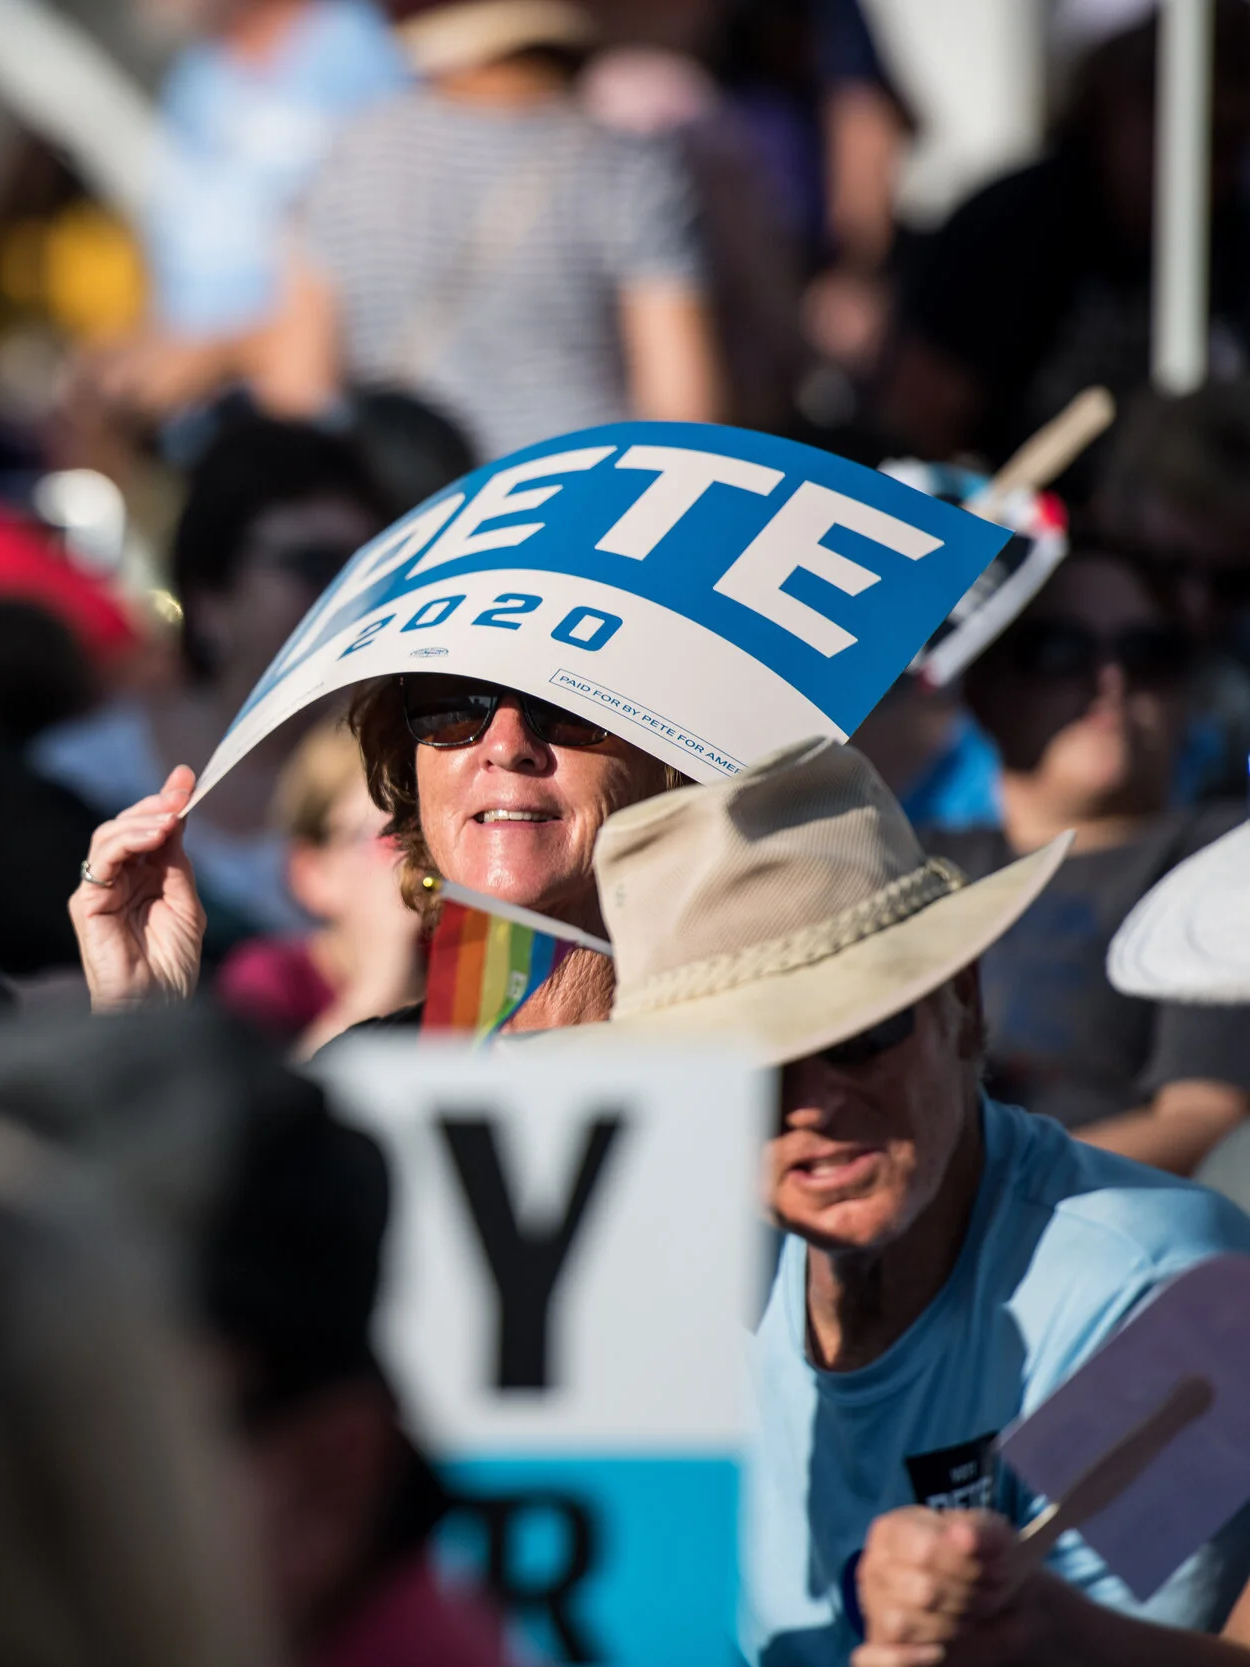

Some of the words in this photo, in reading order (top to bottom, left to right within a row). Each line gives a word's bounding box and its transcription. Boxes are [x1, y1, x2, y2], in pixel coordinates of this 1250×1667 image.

[275, 445, 945, 677] PETE
[337, 592, 623, 661] 2020
[558, 675, 591, 692] PAID
[593, 690, 621, 707] FOR
[622, 704, 641, 717] BY
[641, 715, 676, 738] PETE
[677, 734, 705, 754] FOR
